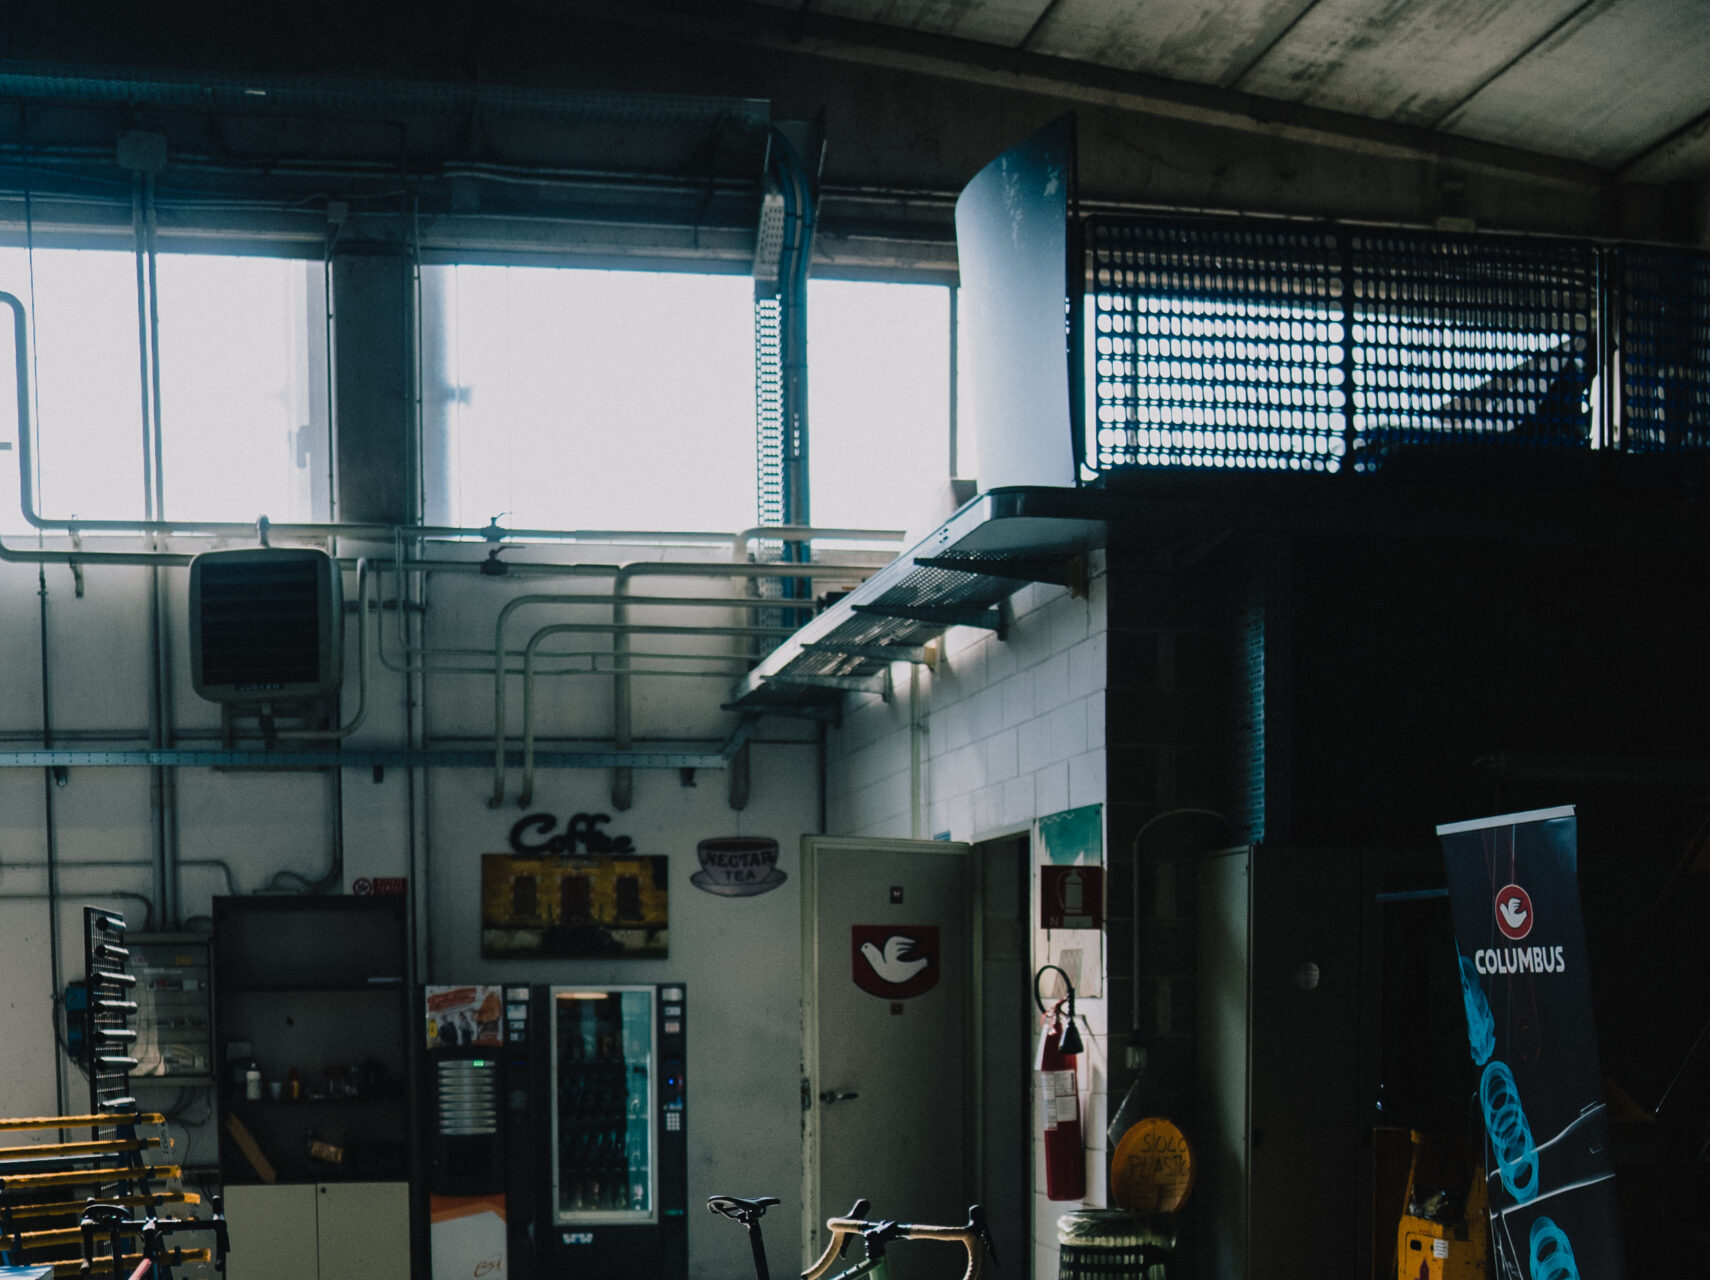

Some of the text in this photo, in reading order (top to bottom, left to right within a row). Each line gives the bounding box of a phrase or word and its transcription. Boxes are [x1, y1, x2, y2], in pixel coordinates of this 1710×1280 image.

[509, 813, 636, 854] Coffee
[706, 851, 775, 868] NECTAR
[724, 869, 756, 882] TEA
[1475, 945, 1565, 975] COLUMBUS
[1141, 1133, 1188, 1153] SOLO
